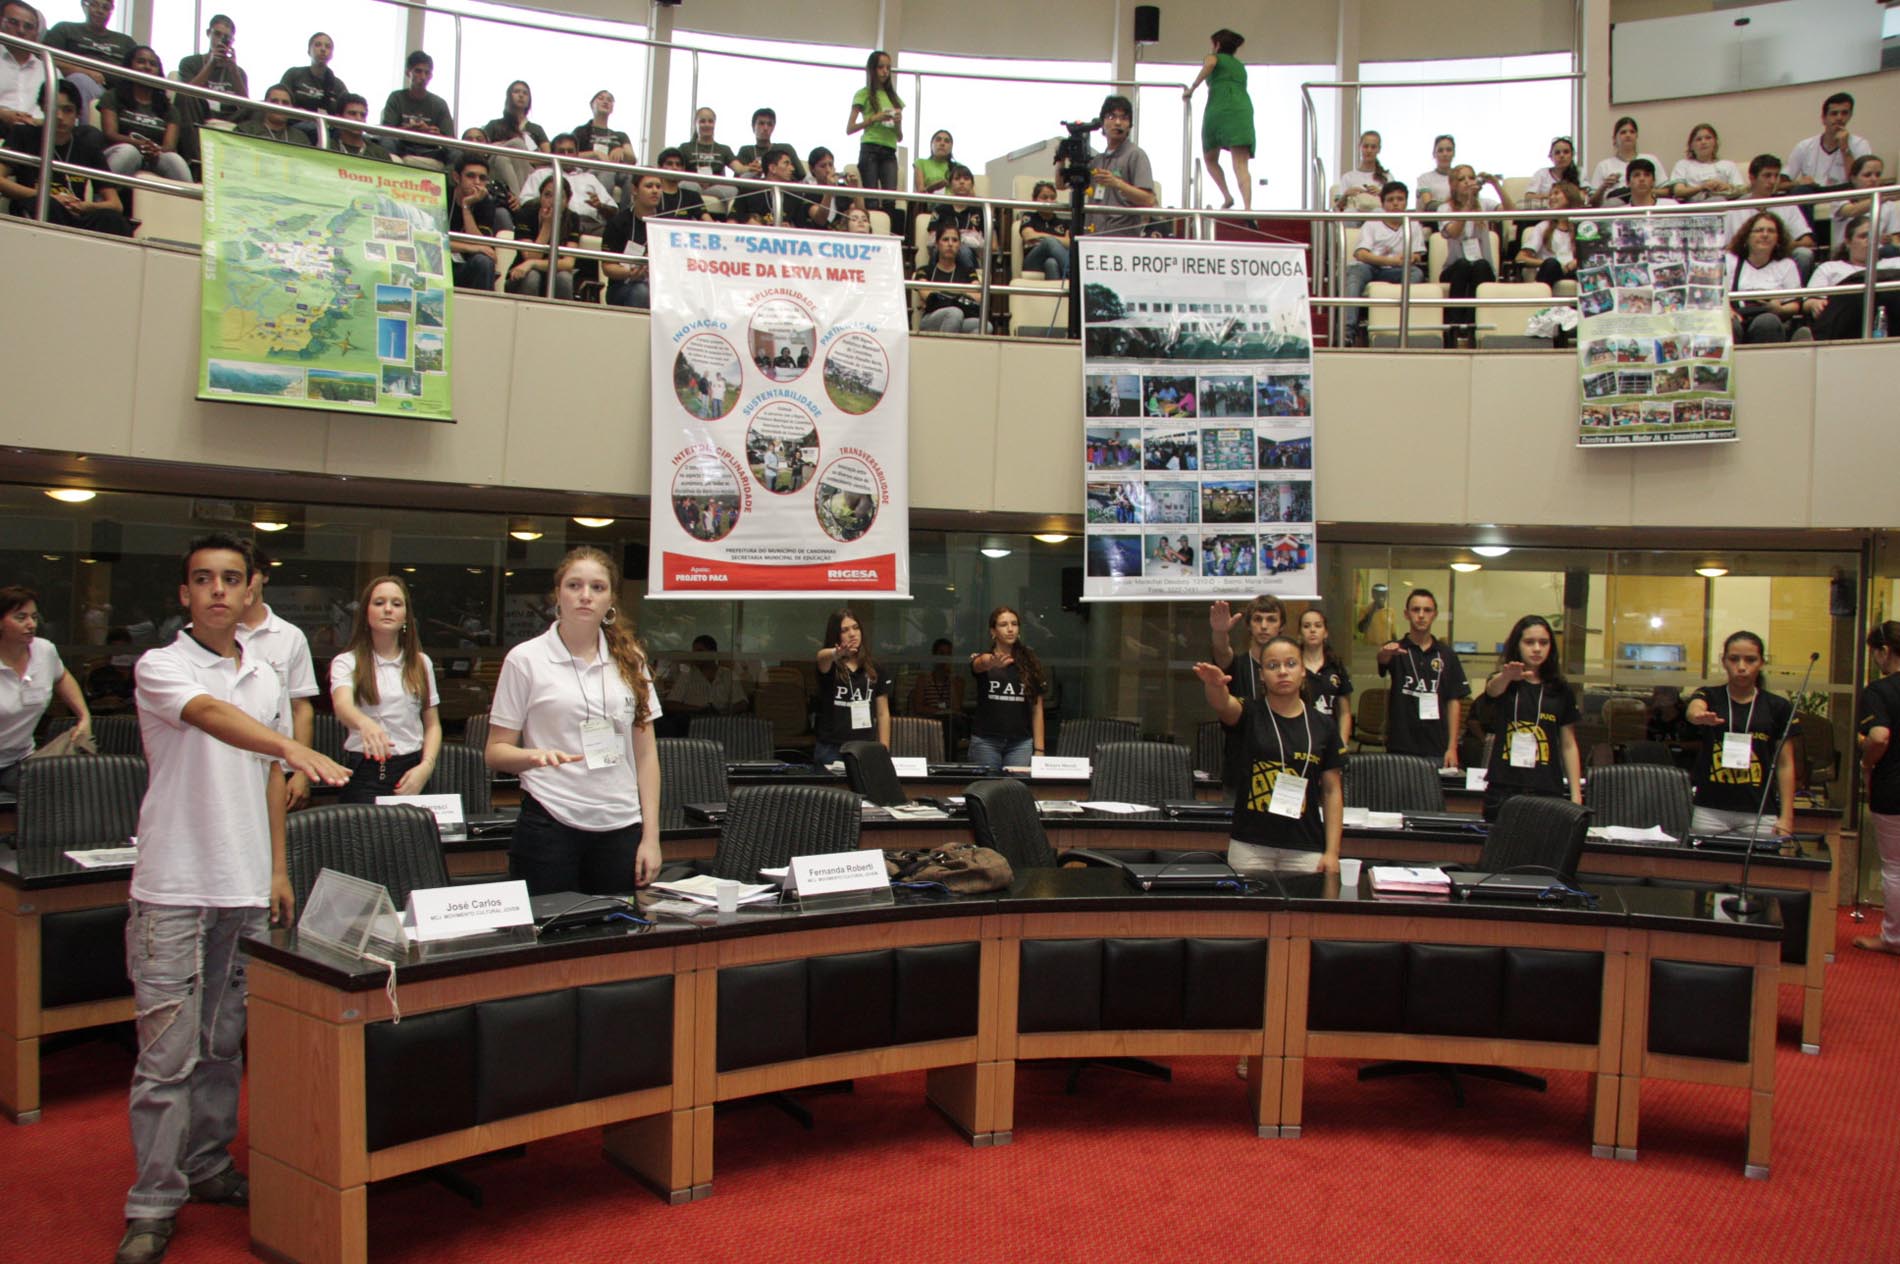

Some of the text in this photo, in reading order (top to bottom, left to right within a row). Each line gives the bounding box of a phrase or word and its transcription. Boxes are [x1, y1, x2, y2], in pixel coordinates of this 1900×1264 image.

[338, 168, 373, 184] Bom
[391, 188, 439, 205] Serra
[670, 232, 727, 251] E.E.B.
[687, 258, 865, 283] BOSQUE DA ERVA MATE
[1086, 255, 1127, 272] E.E.B.
[1182, 257, 1226, 275] IRENE
[1231, 259, 1304, 277] STONOGA
[672, 319, 727, 343] INOVAÇÃO
[743, 388, 822, 417] SUSTENTABILIDADE
[672, 444, 752, 513] INTERDICIPLINARIDADE
[675, 574, 707, 582] PROJETO
[828, 570, 878, 579] RIGESA
[809, 866, 845, 876] Fernanda
[446, 898, 502, 912] José Carlos
